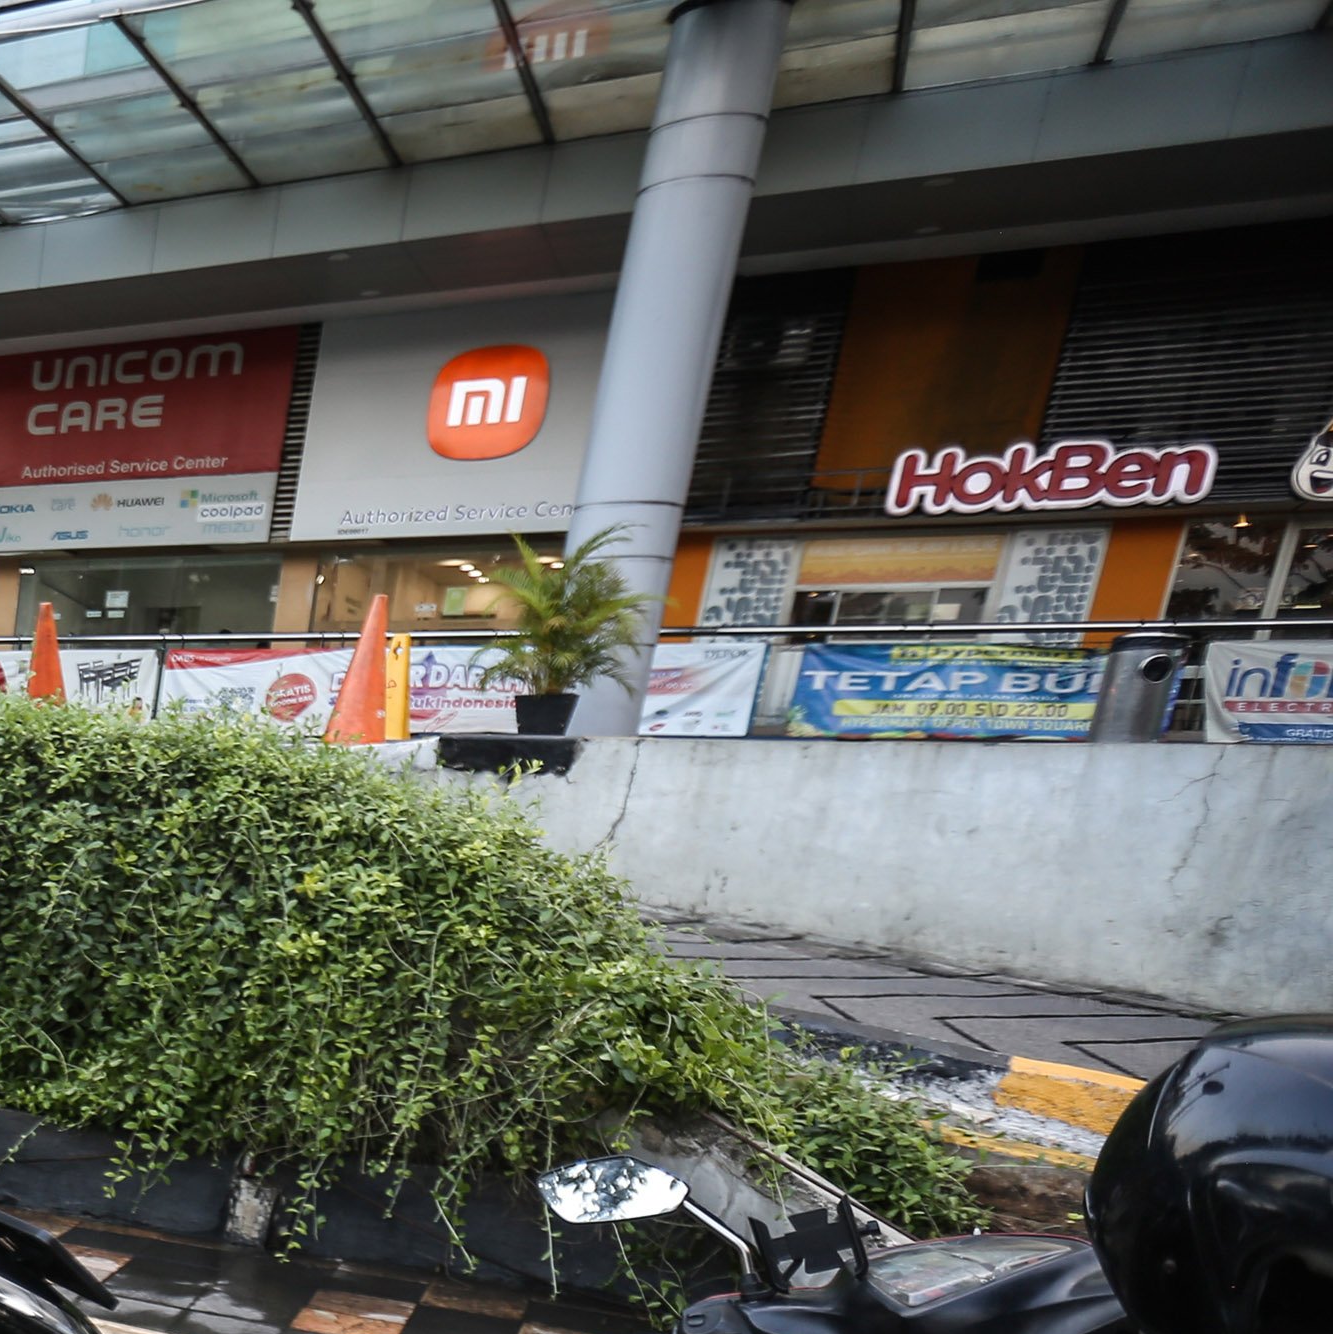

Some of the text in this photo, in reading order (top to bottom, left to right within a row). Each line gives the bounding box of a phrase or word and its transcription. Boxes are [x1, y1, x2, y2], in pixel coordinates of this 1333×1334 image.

[32, 342, 244, 391] UNICOM
[27, 394, 165, 436] CARE
[21, 454, 229, 480] Authorised Service Center
[891, 443, 1213, 511] HokBen
[117, 496, 165, 508] HUAWEI
[200, 489, 259, 504] Microsoft
[200, 504, 265, 519] coolpad
[340, 500, 576, 526] Authorized Service Cen
[52, 530, 89, 541] ASUS
[802, 671, 988, 692] TETAP
[871, 703, 906, 715] JAM
[917, 703, 966, 717] 09.00
[1014, 703, 1069, 718] 22.00
